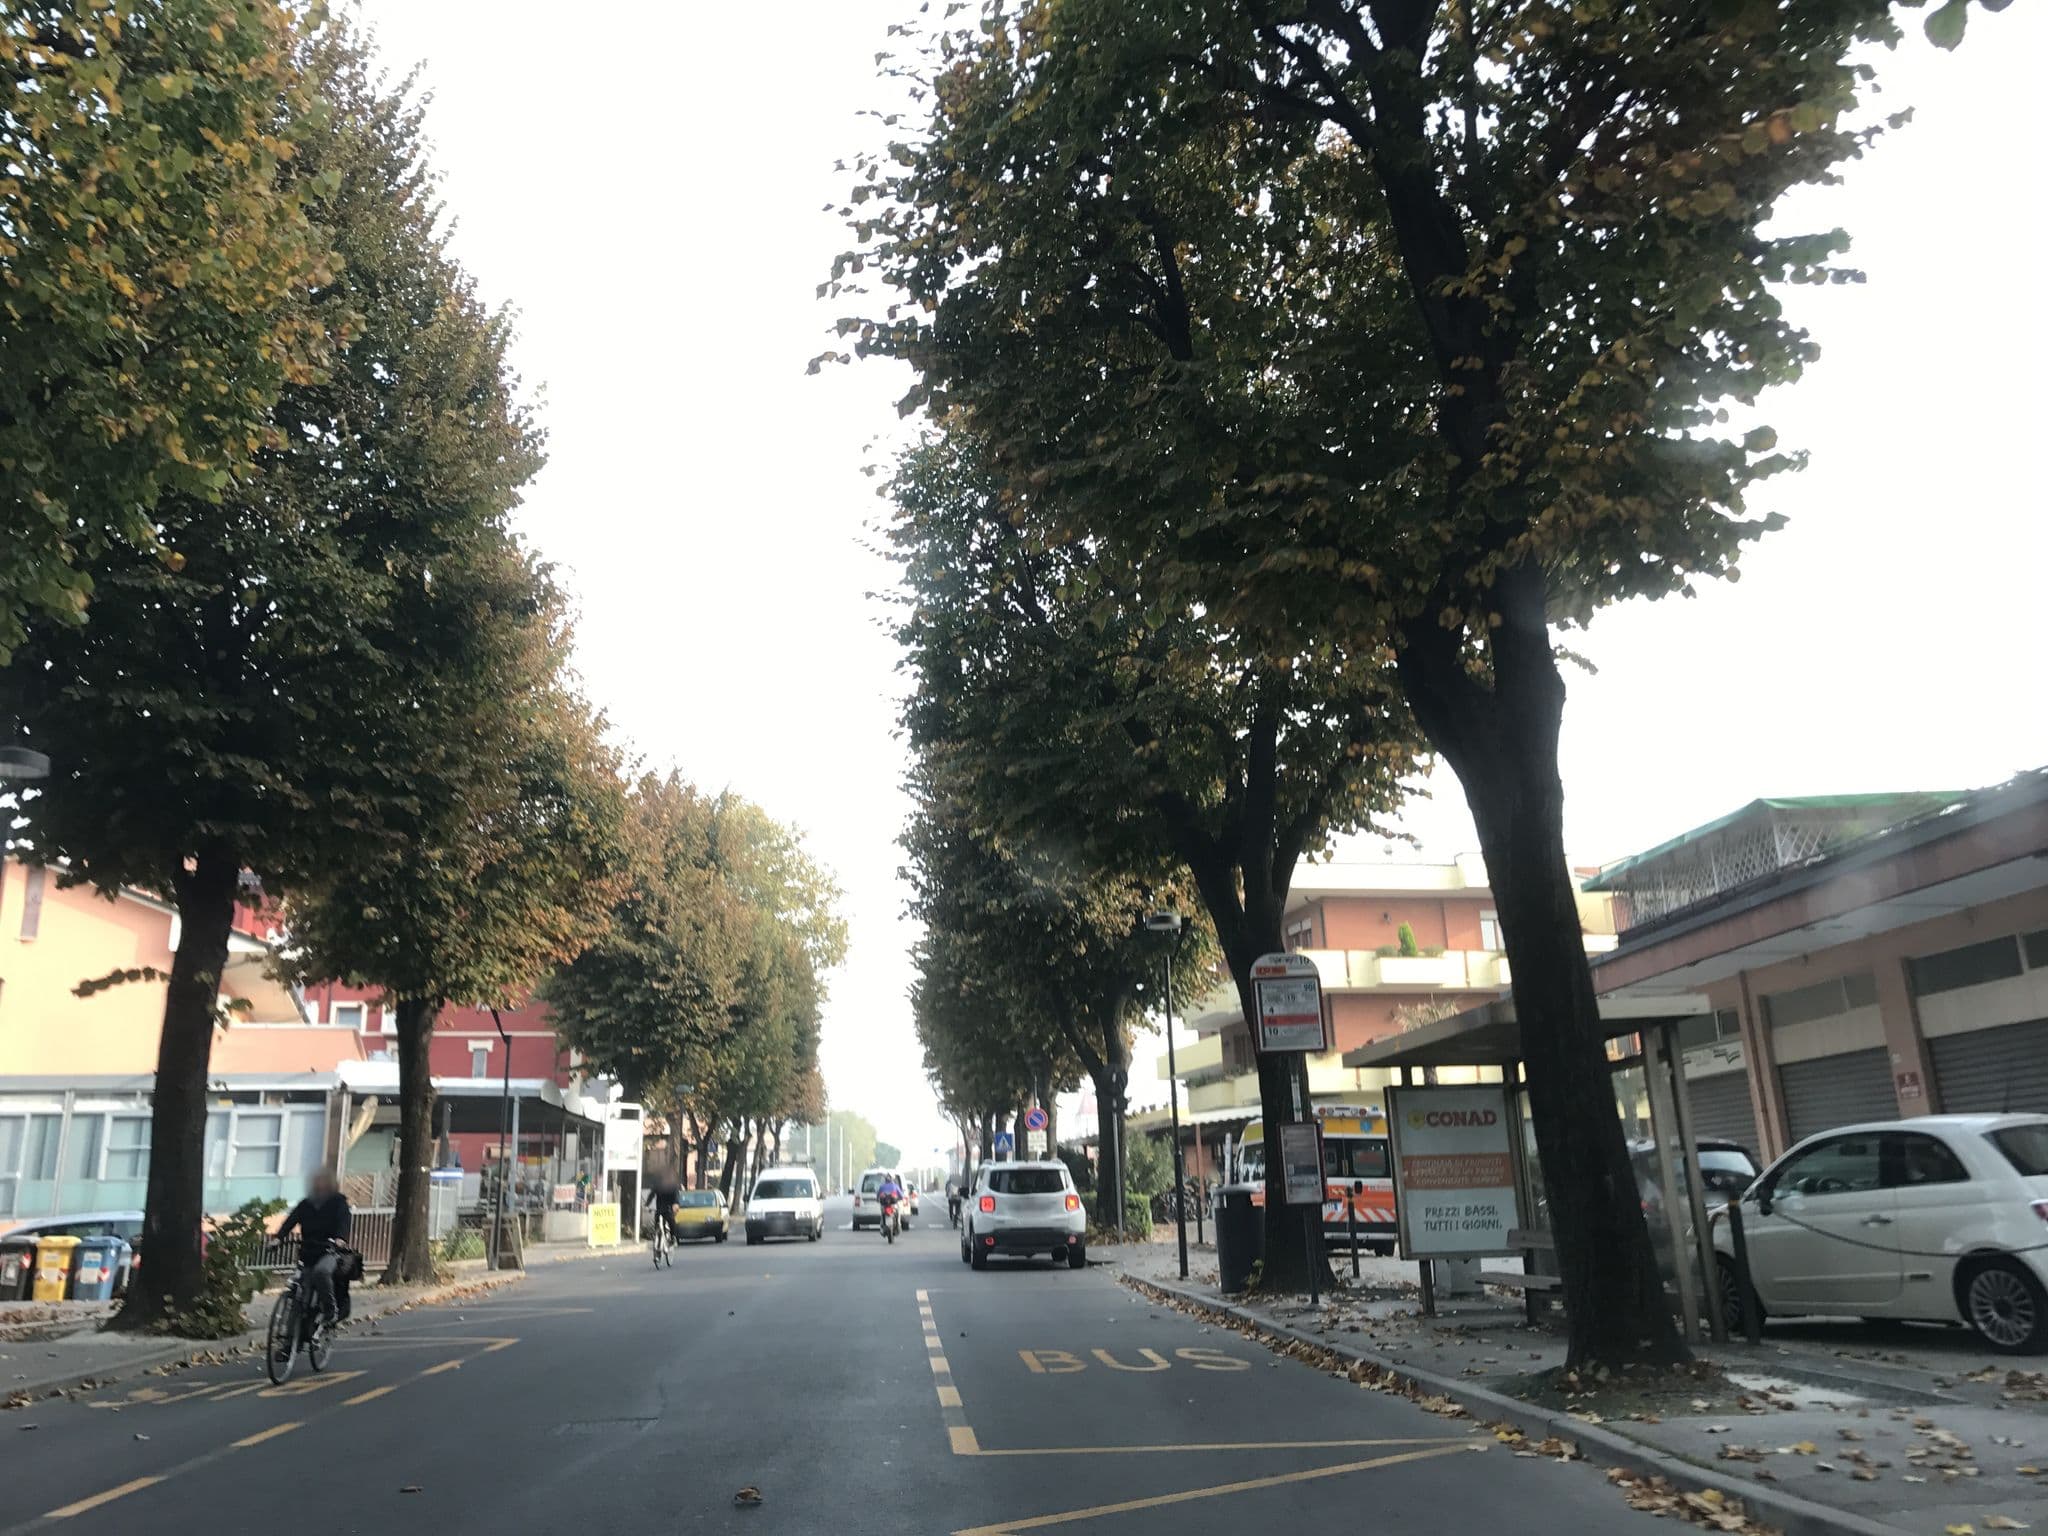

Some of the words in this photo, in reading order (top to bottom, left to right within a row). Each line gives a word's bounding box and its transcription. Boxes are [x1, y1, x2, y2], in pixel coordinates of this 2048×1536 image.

[1426, 1110, 1498, 1128] CONAD
[1425, 1206, 1461, 1218] PREZZI
[1423, 1221, 1453, 1232] TUTTI
[1018, 1347, 1252, 1374] BUS
